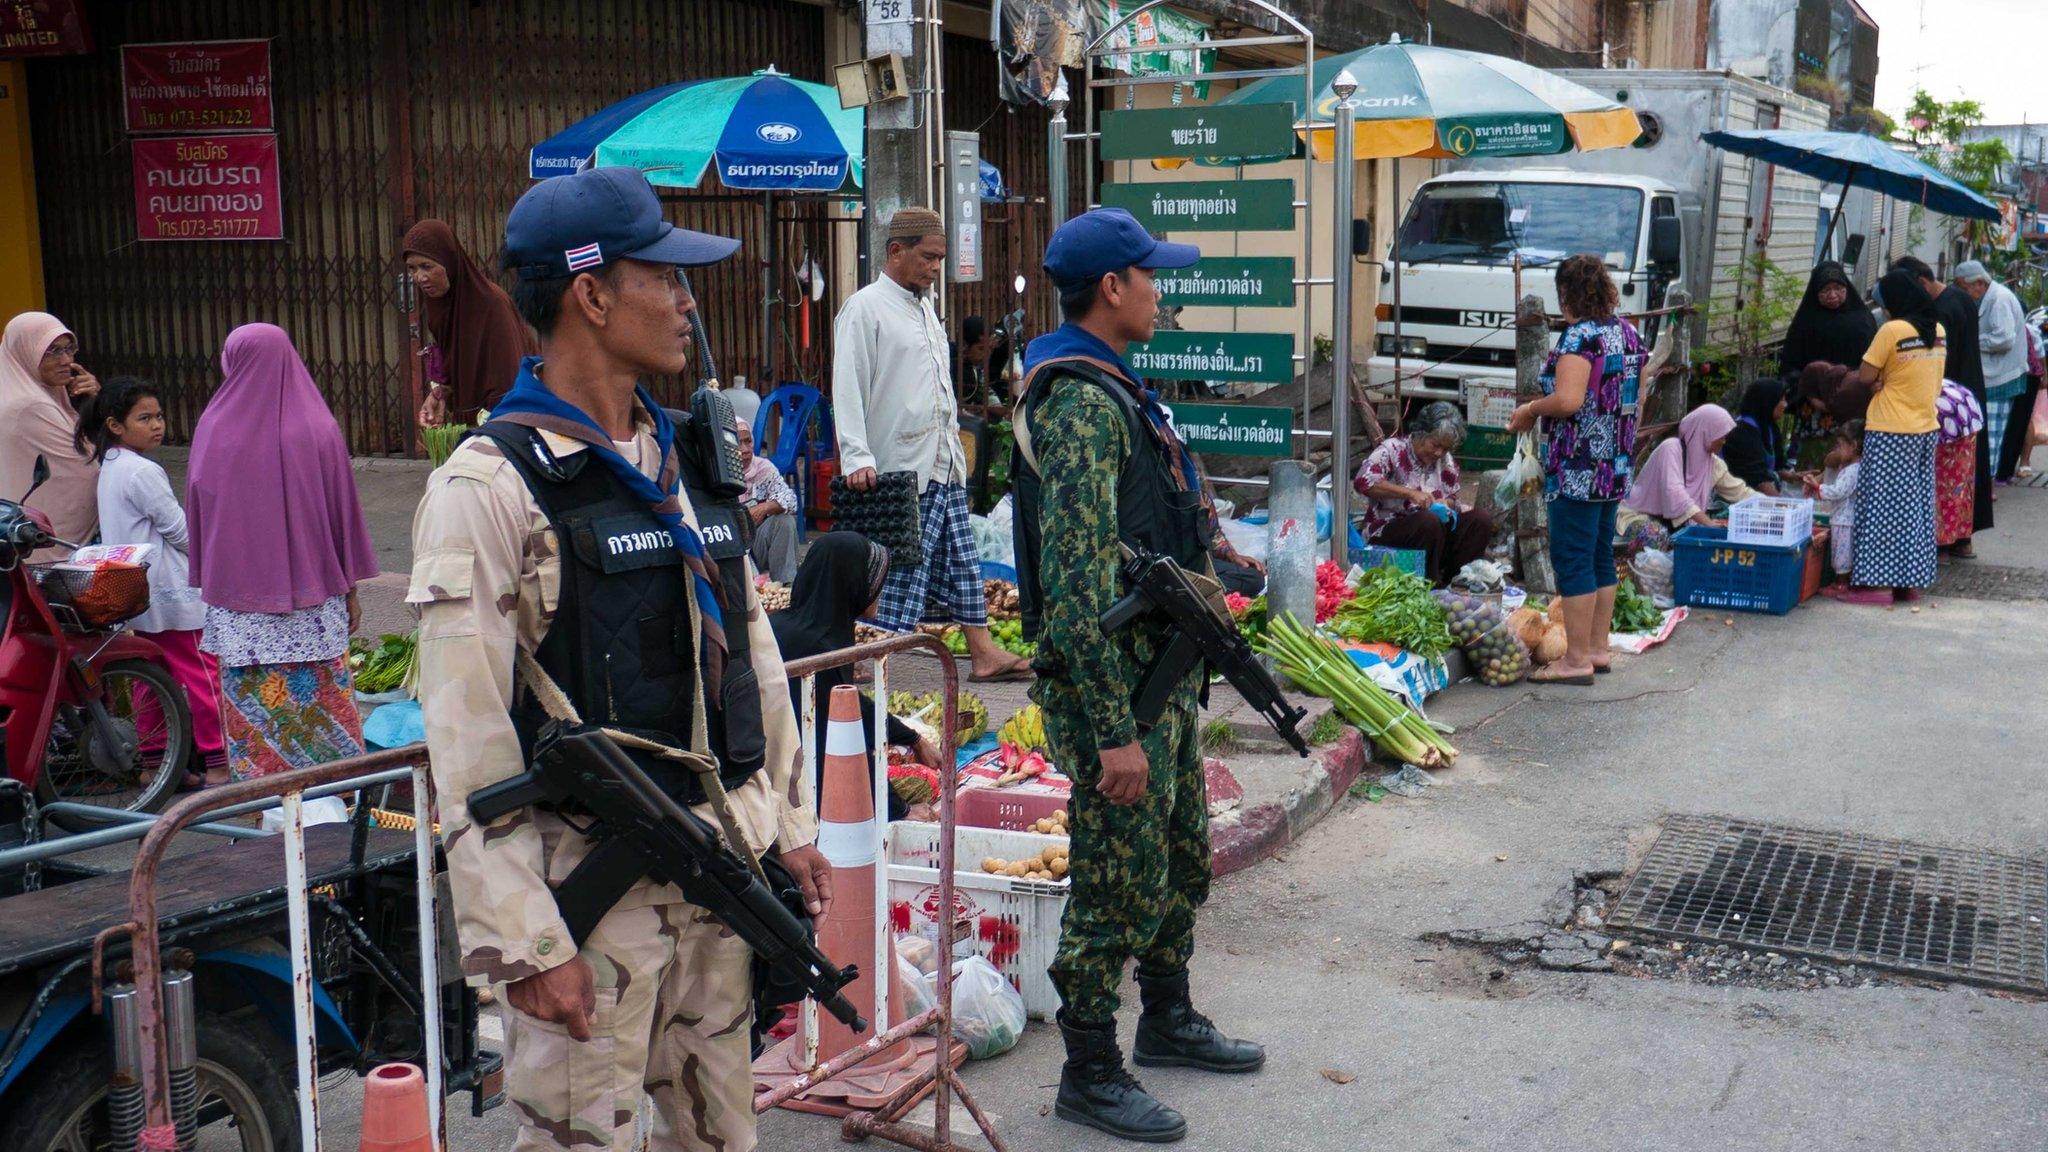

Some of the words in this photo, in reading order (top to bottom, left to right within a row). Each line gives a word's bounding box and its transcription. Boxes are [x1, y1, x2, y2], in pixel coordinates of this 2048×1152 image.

[880, 0, 900, 19] 58
[168, 51, 221, 74] รับสมัคร
[1171, 119, 1217, 145] ขยะร้าย
[1475, 122, 1551, 137] ธนาคารอิสลาม
[176, 142, 228, 161] รับสมัคร
[148, 163, 261, 187] คนขับรถ
[728, 161, 838, 178] ธนาคารกรุงไทย
[150, 193, 263, 213] คนยกของ
[1152, 189, 1237, 222] ทำลายทุกอย่าง
[1153, 270, 1263, 296] องช่วยกันกวาดล้าง
[1459, 311, 1517, 329] ISUZ
[1176, 412, 1283, 444] สุขและสิ่งแวดล้อม
[1738, 550, 1756, 566] 52
